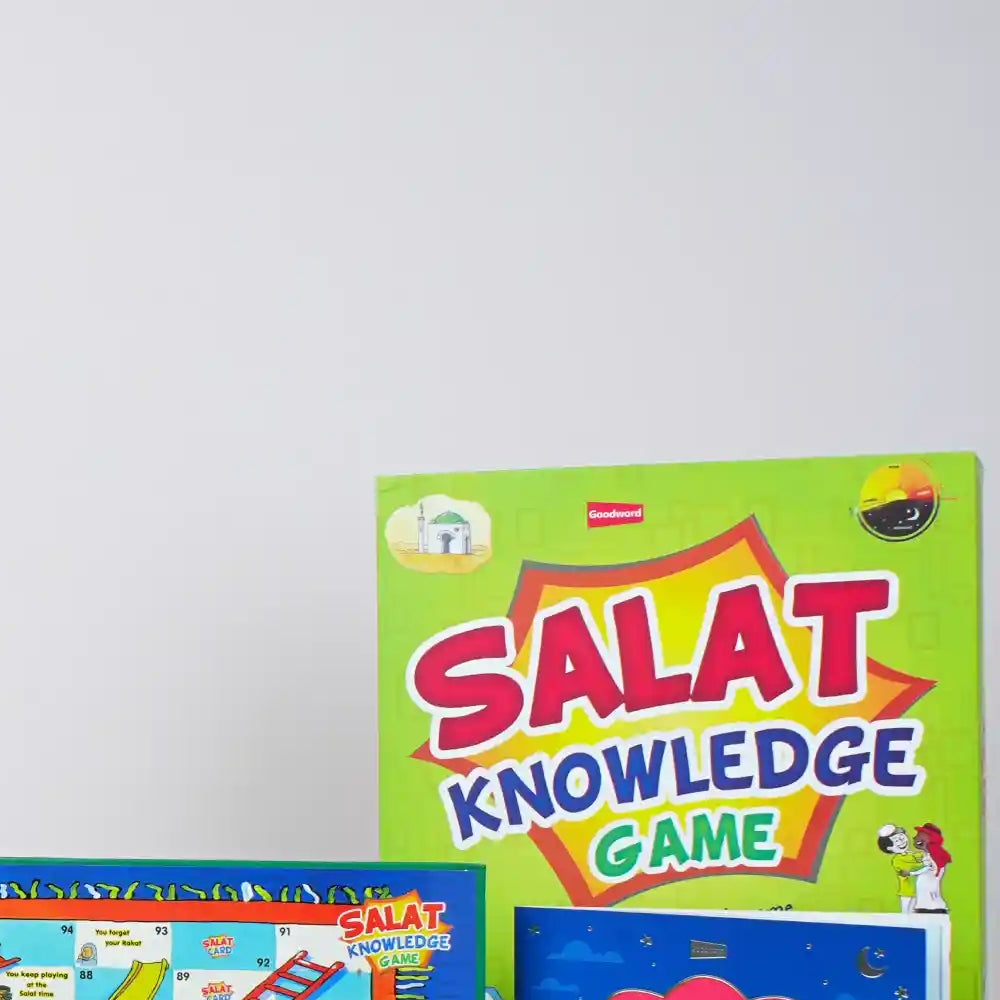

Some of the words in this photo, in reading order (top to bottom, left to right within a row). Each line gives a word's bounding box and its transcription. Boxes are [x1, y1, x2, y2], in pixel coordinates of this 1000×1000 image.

[412, 577, 890, 752] SALAT
[447, 725, 916, 842] KNOWLEDGE
[593, 811, 778, 877] GAME
[339, 903, 443, 939] SALAT
[60, 924, 74, 935] 94
[94, 928, 108, 936] You
[108, 928, 130, 937] forget
[155, 926, 169, 936] 93
[279, 927, 291, 936] 91
[104, 940, 121, 948] your
[202, 937, 233, 947] SALAT
[347, 934, 450, 959] KNOWLEDGE
[207, 946, 232, 955] CARD
[379, 952, 419, 968] GAME
[5, 970, 20, 978] You
[20, 971, 40, 979] keep
[40, 970, 69, 980] playing
[79, 970, 93, 980] 88
